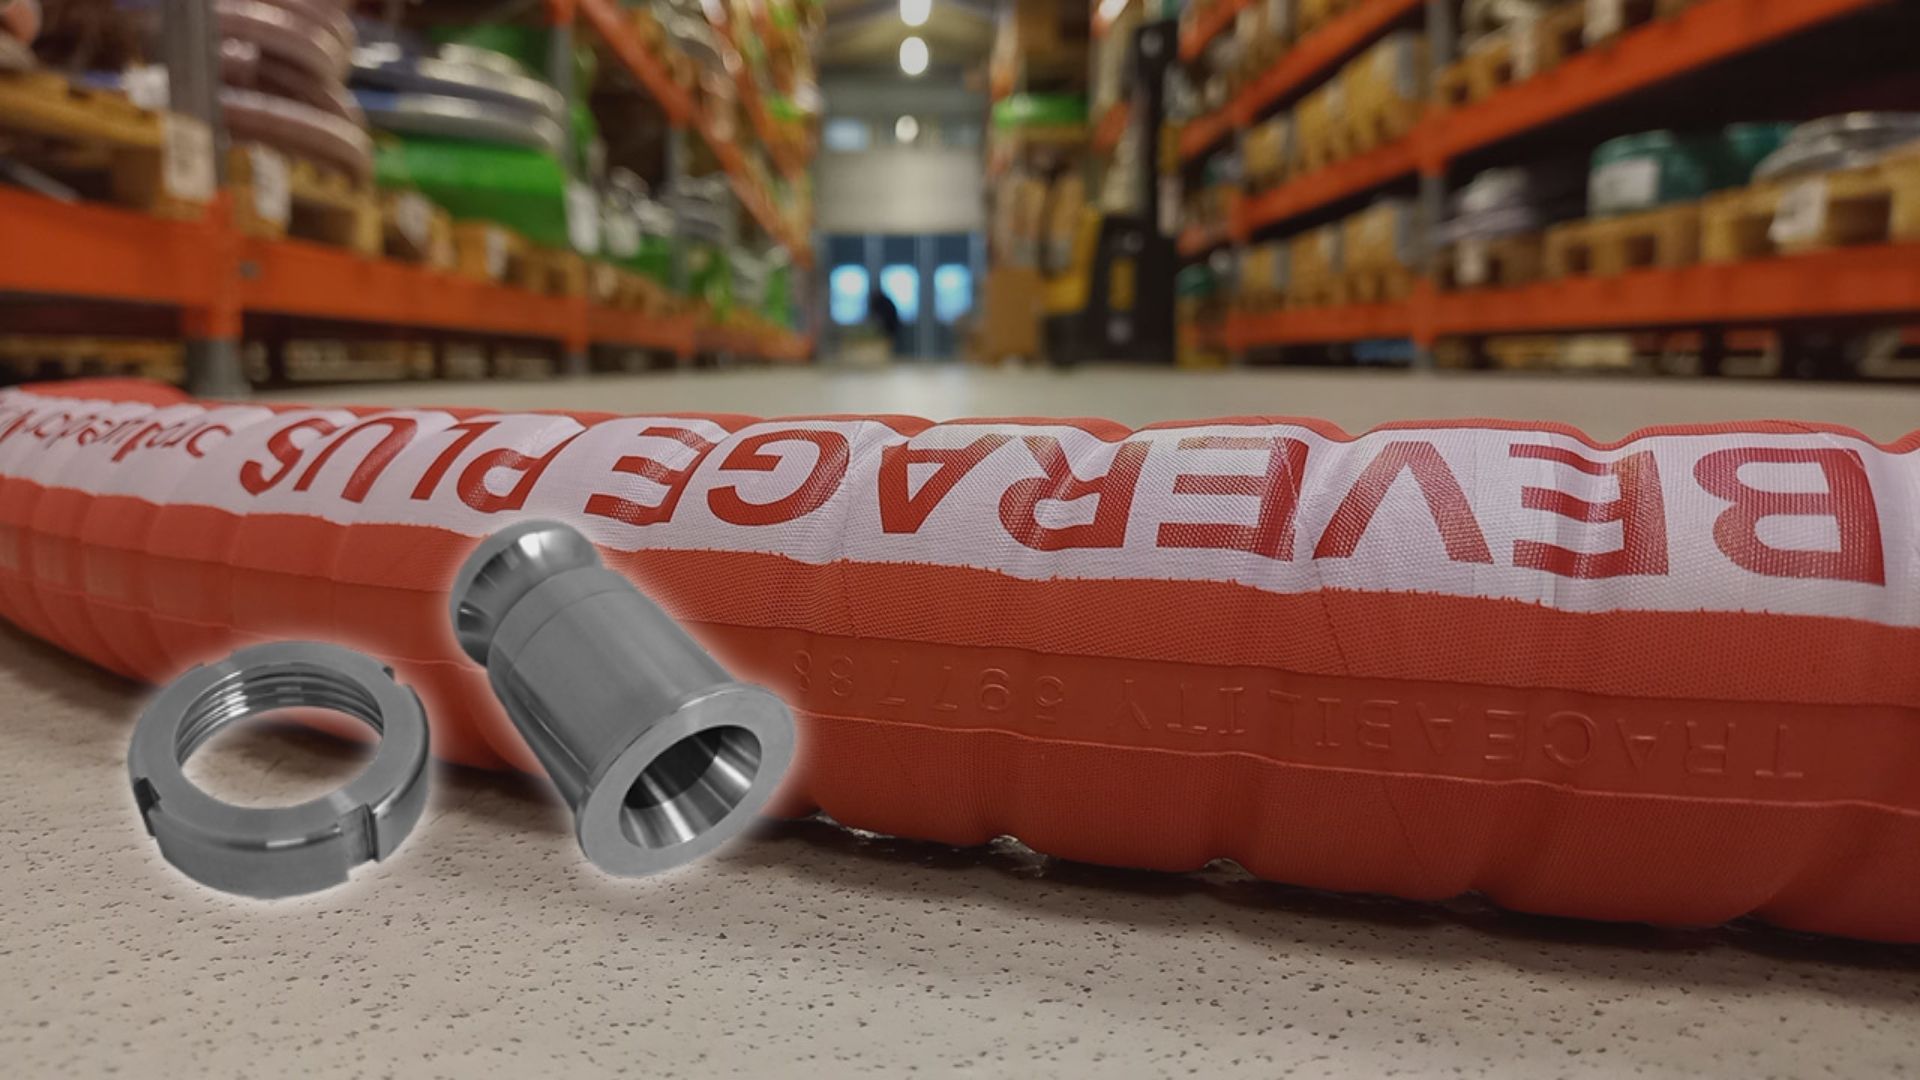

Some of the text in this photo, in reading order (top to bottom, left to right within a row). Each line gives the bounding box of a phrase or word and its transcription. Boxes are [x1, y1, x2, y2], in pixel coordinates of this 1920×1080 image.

[239, 416, 589, 514] PLUS
[583, 426, 1885, 587] BEVERAGE
[1107, 676, 1804, 778] TRACEABILITY
